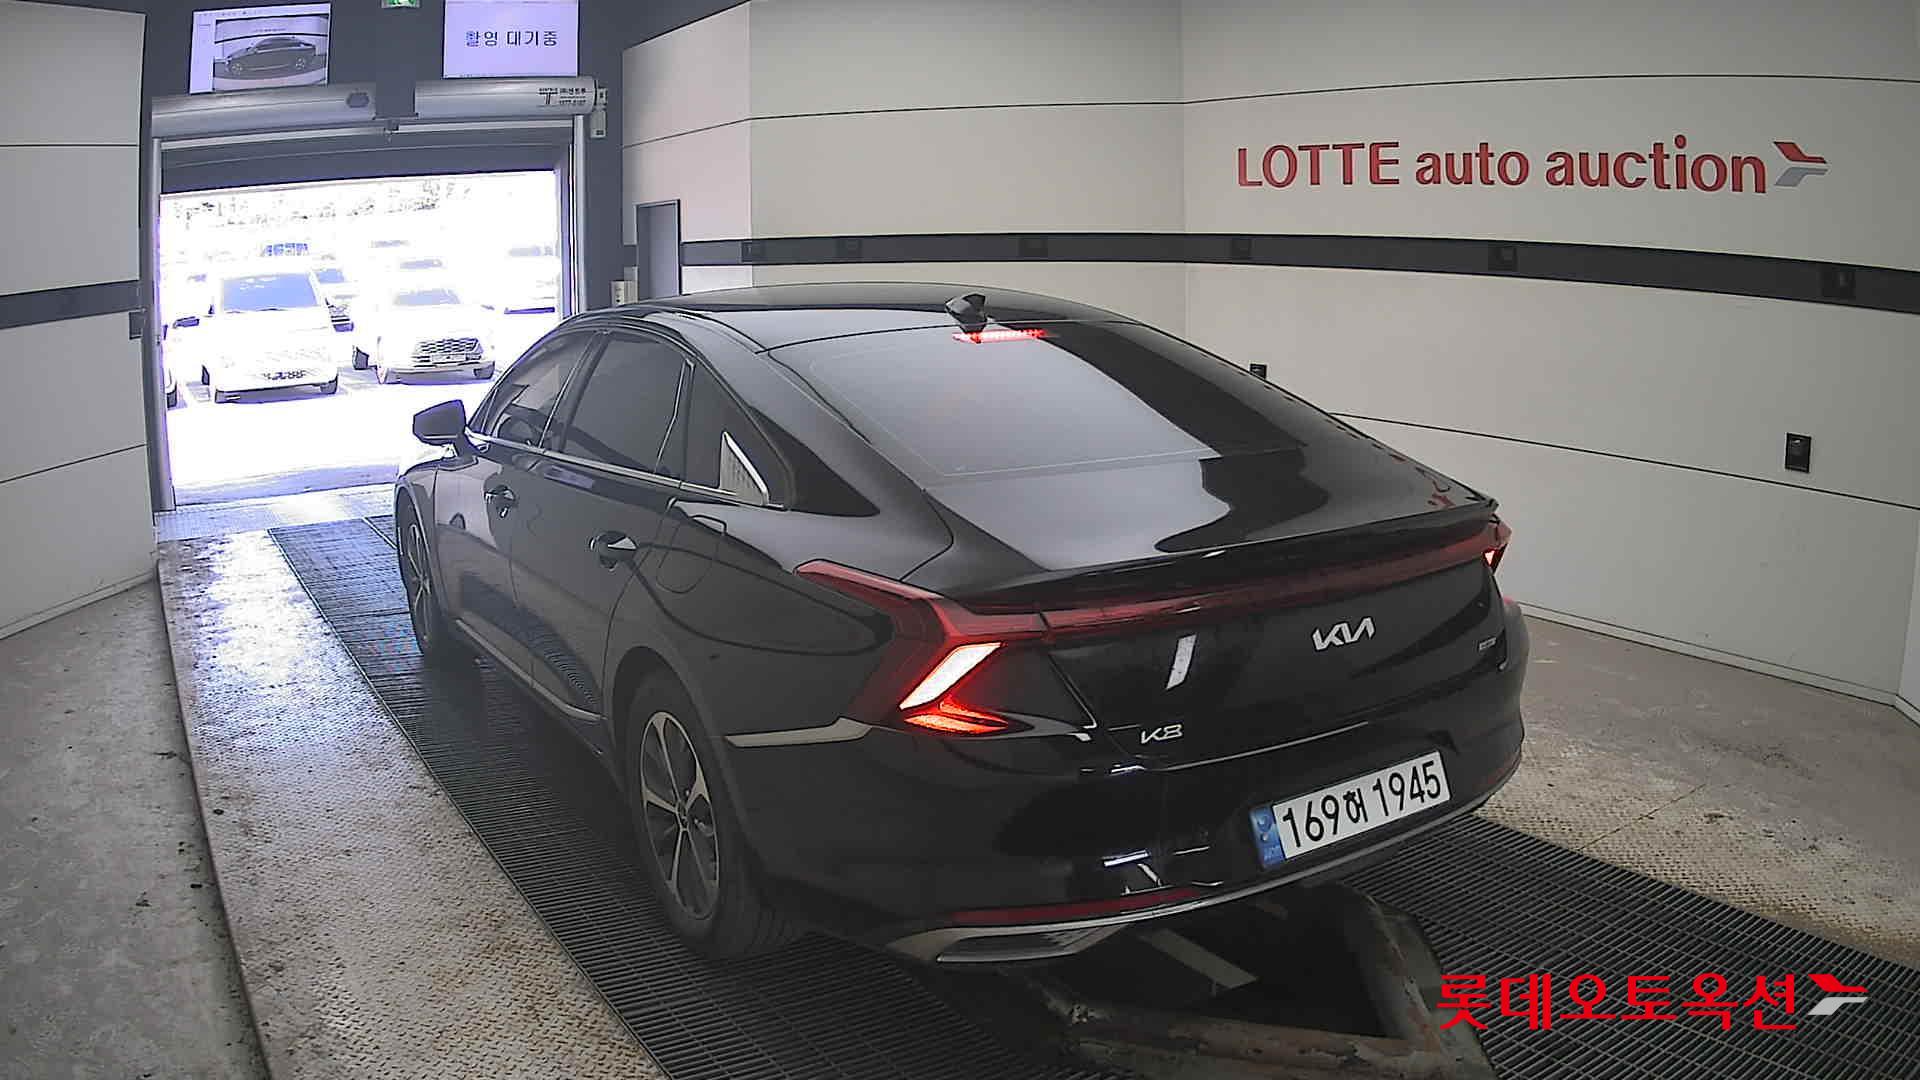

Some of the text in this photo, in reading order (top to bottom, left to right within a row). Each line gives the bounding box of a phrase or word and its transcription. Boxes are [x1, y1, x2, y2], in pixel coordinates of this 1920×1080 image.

[506, 30, 558, 47] 대기중
[1237, 134, 1767, 194] LOTTE auto auction
[1141, 724, 1183, 744] K8
[1282, 760, 1441, 848] 169허 1945
